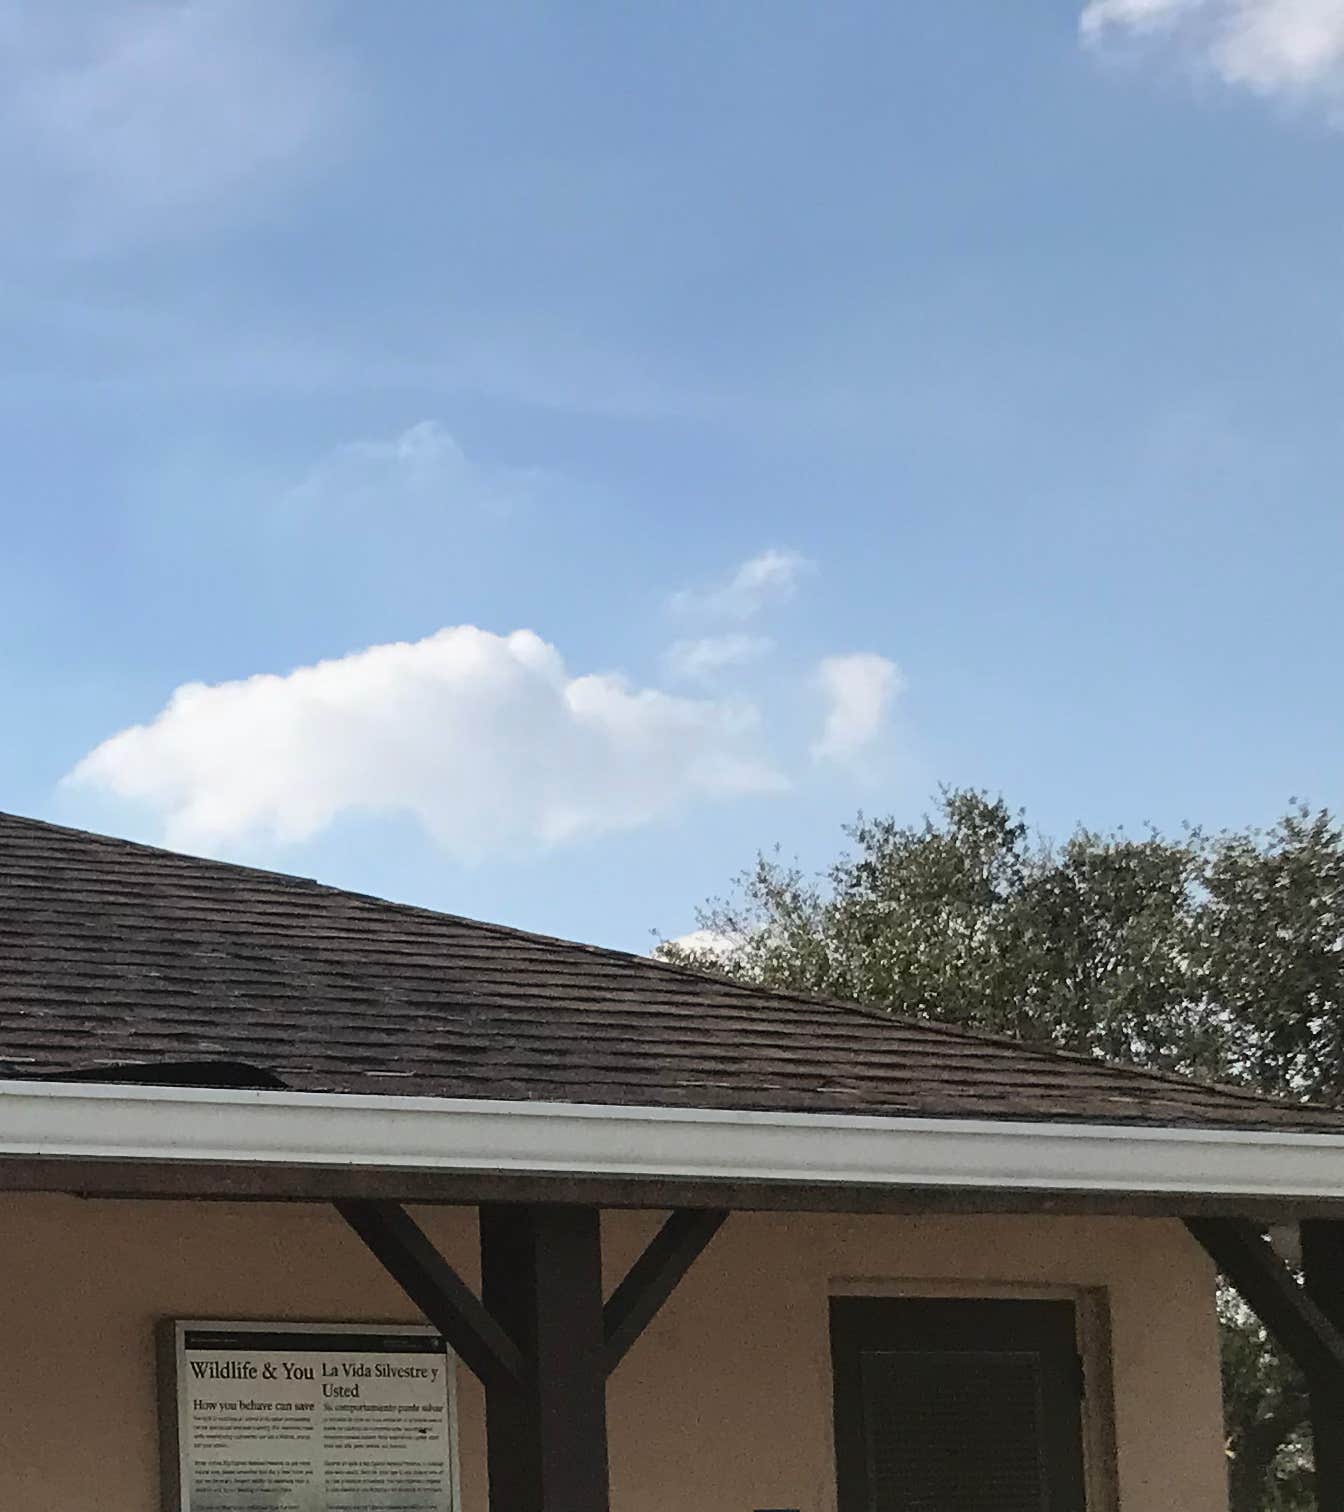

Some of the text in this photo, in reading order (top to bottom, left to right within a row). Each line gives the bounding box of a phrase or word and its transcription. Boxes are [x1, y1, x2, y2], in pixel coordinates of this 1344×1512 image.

[190, 1361, 315, 1380] Wildlife & You
[322, 1363, 439, 1383] La Vida Silvestre y
[322, 1383, 360, 1398] Usted
[193, 1400, 315, 1413] How you behave can save
